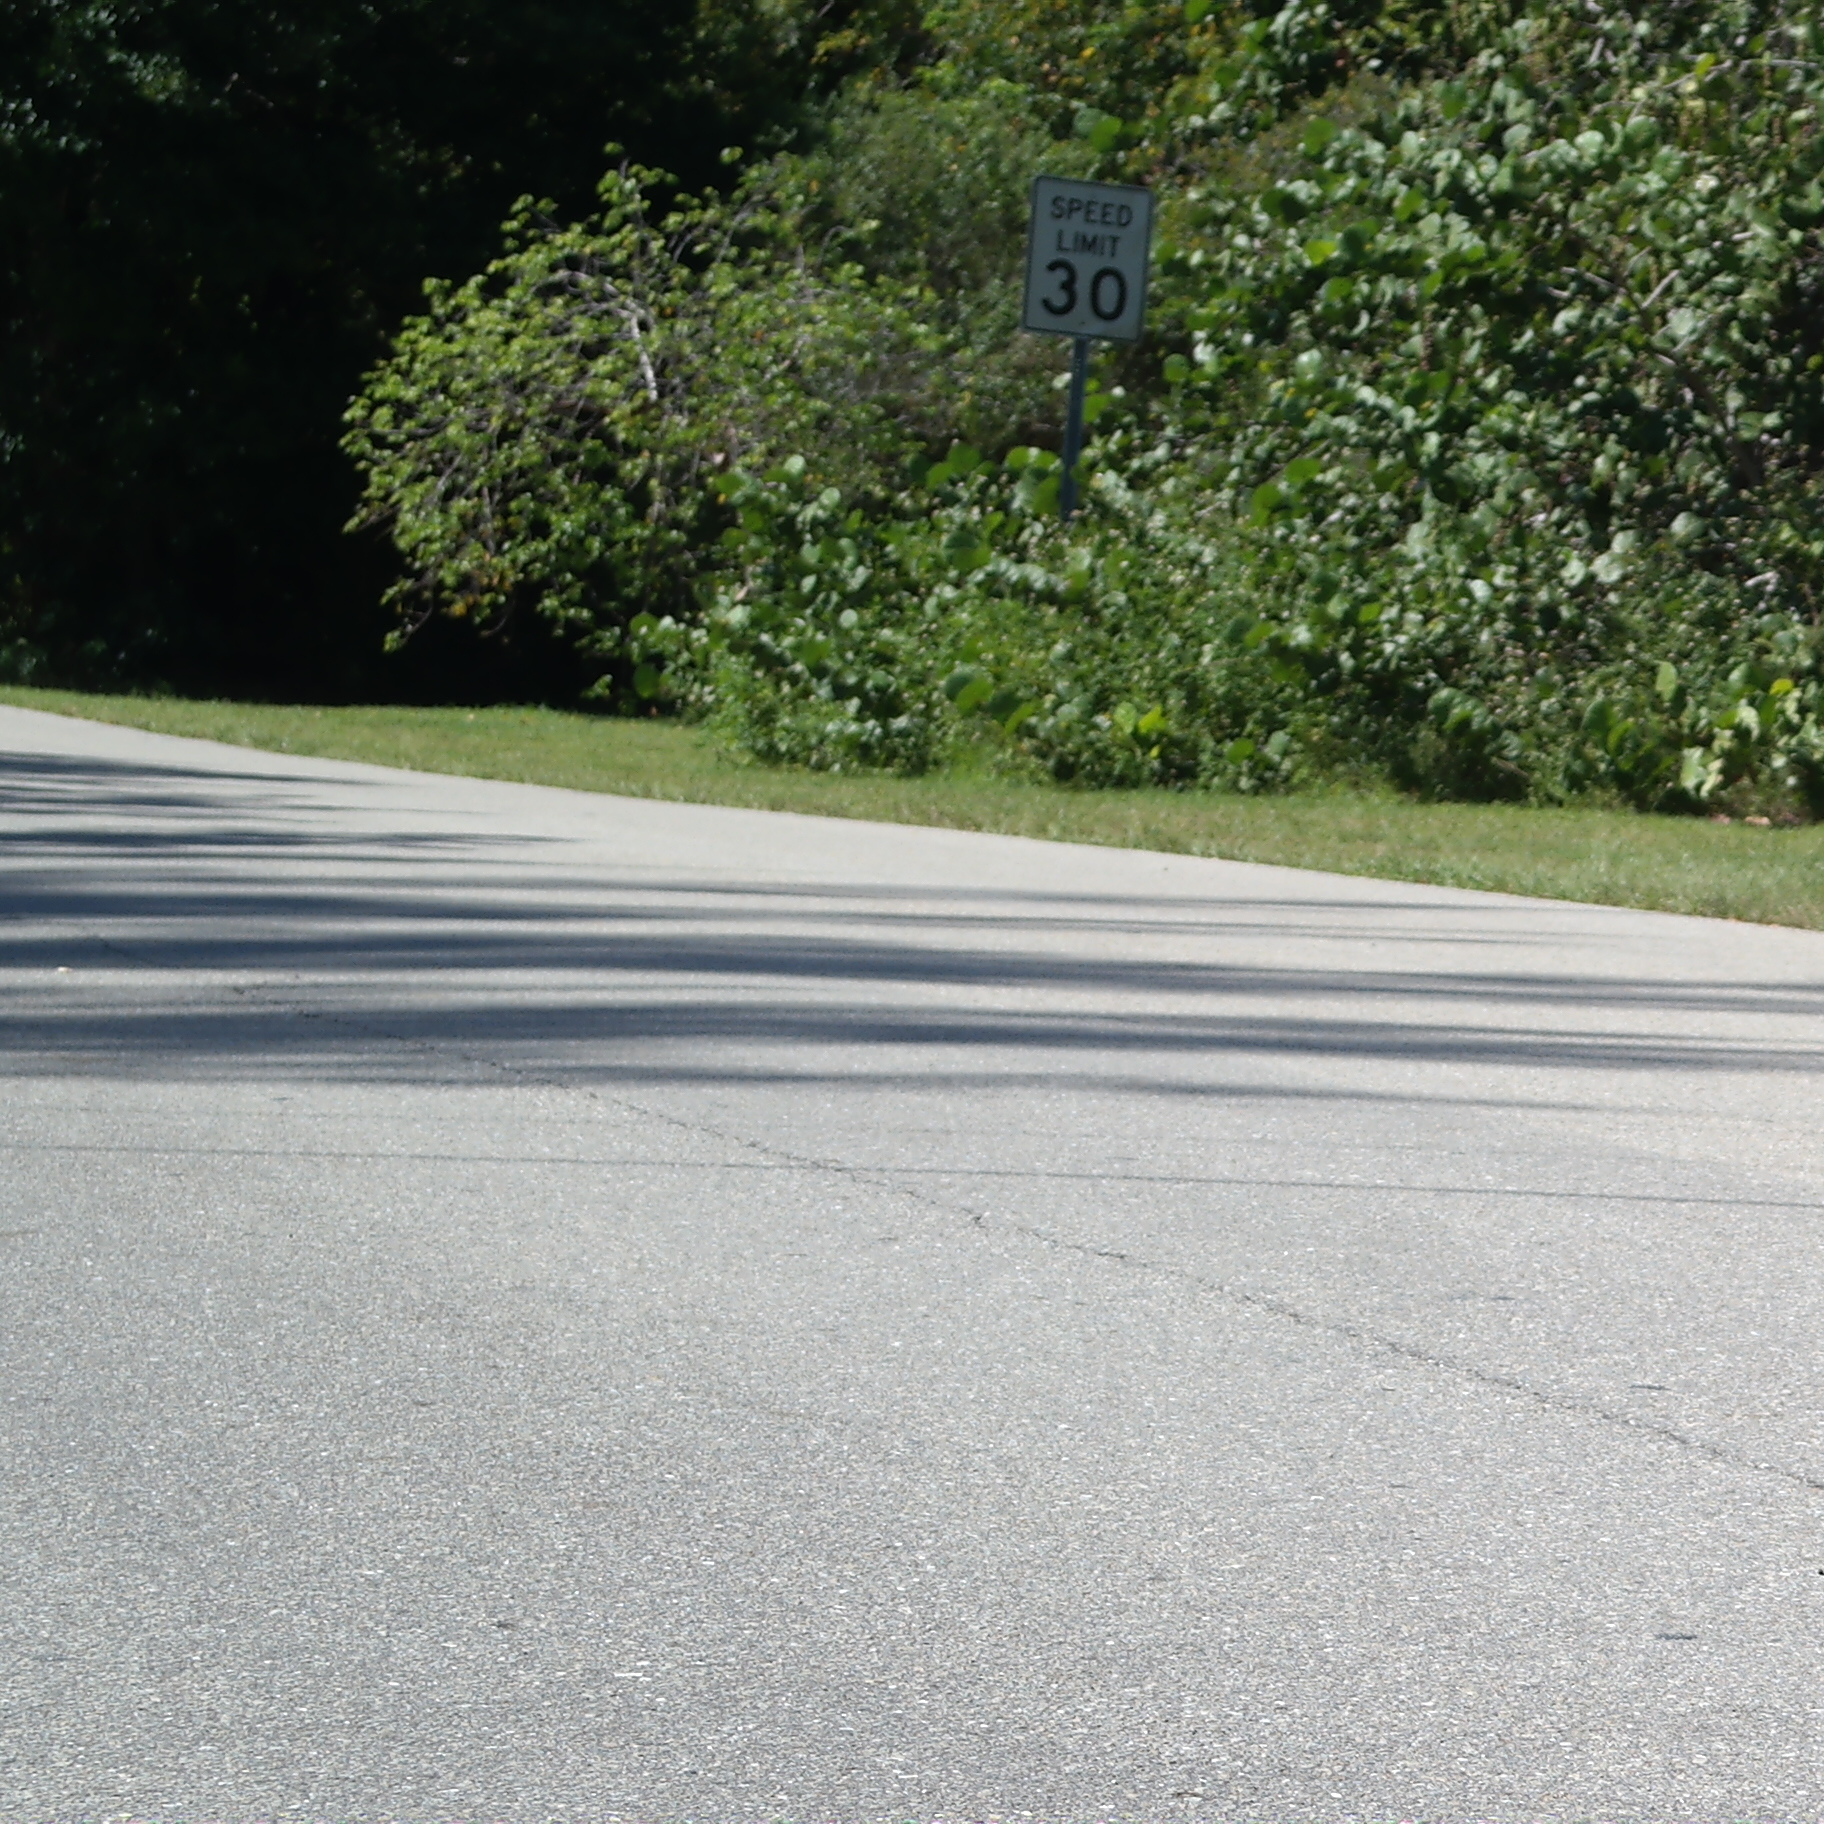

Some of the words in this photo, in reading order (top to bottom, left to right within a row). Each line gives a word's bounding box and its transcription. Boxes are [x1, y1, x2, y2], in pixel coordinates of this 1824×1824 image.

[1051, 196, 1133, 226] SPEED
[1056, 229, 1121, 257] LIMIT
[1041, 258, 1127, 321] 30
